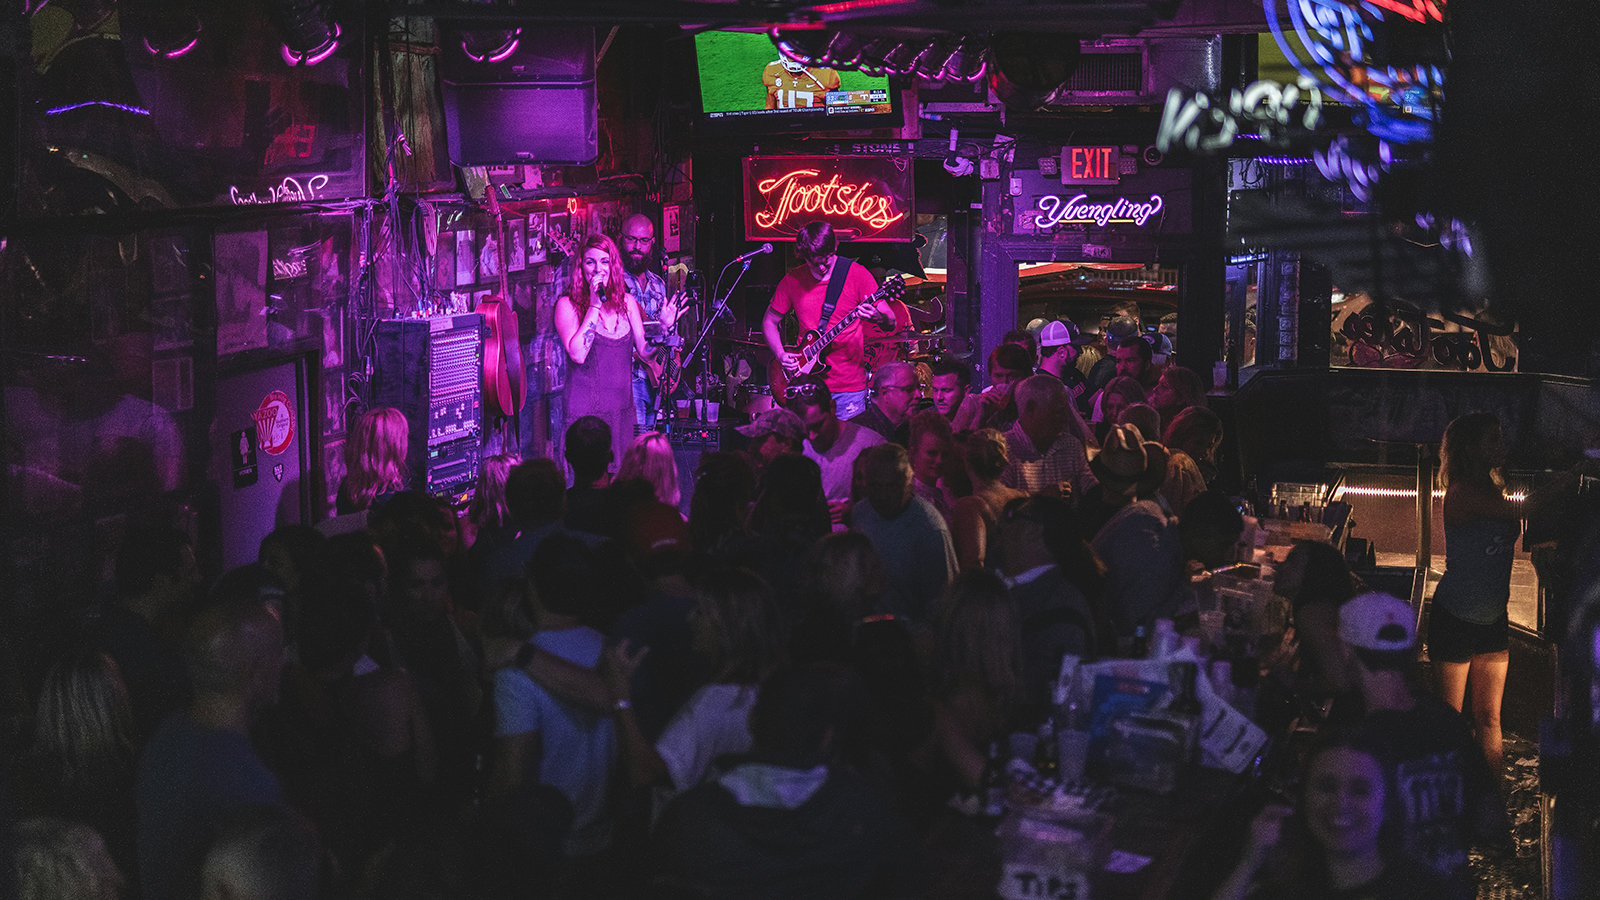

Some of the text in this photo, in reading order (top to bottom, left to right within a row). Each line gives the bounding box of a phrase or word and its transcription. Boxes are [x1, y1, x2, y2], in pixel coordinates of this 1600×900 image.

[1071, 148, 1112, 179] EXIT
[755, 168, 904, 228] Tootsies
[1034, 194, 1163, 229] Yuengling
